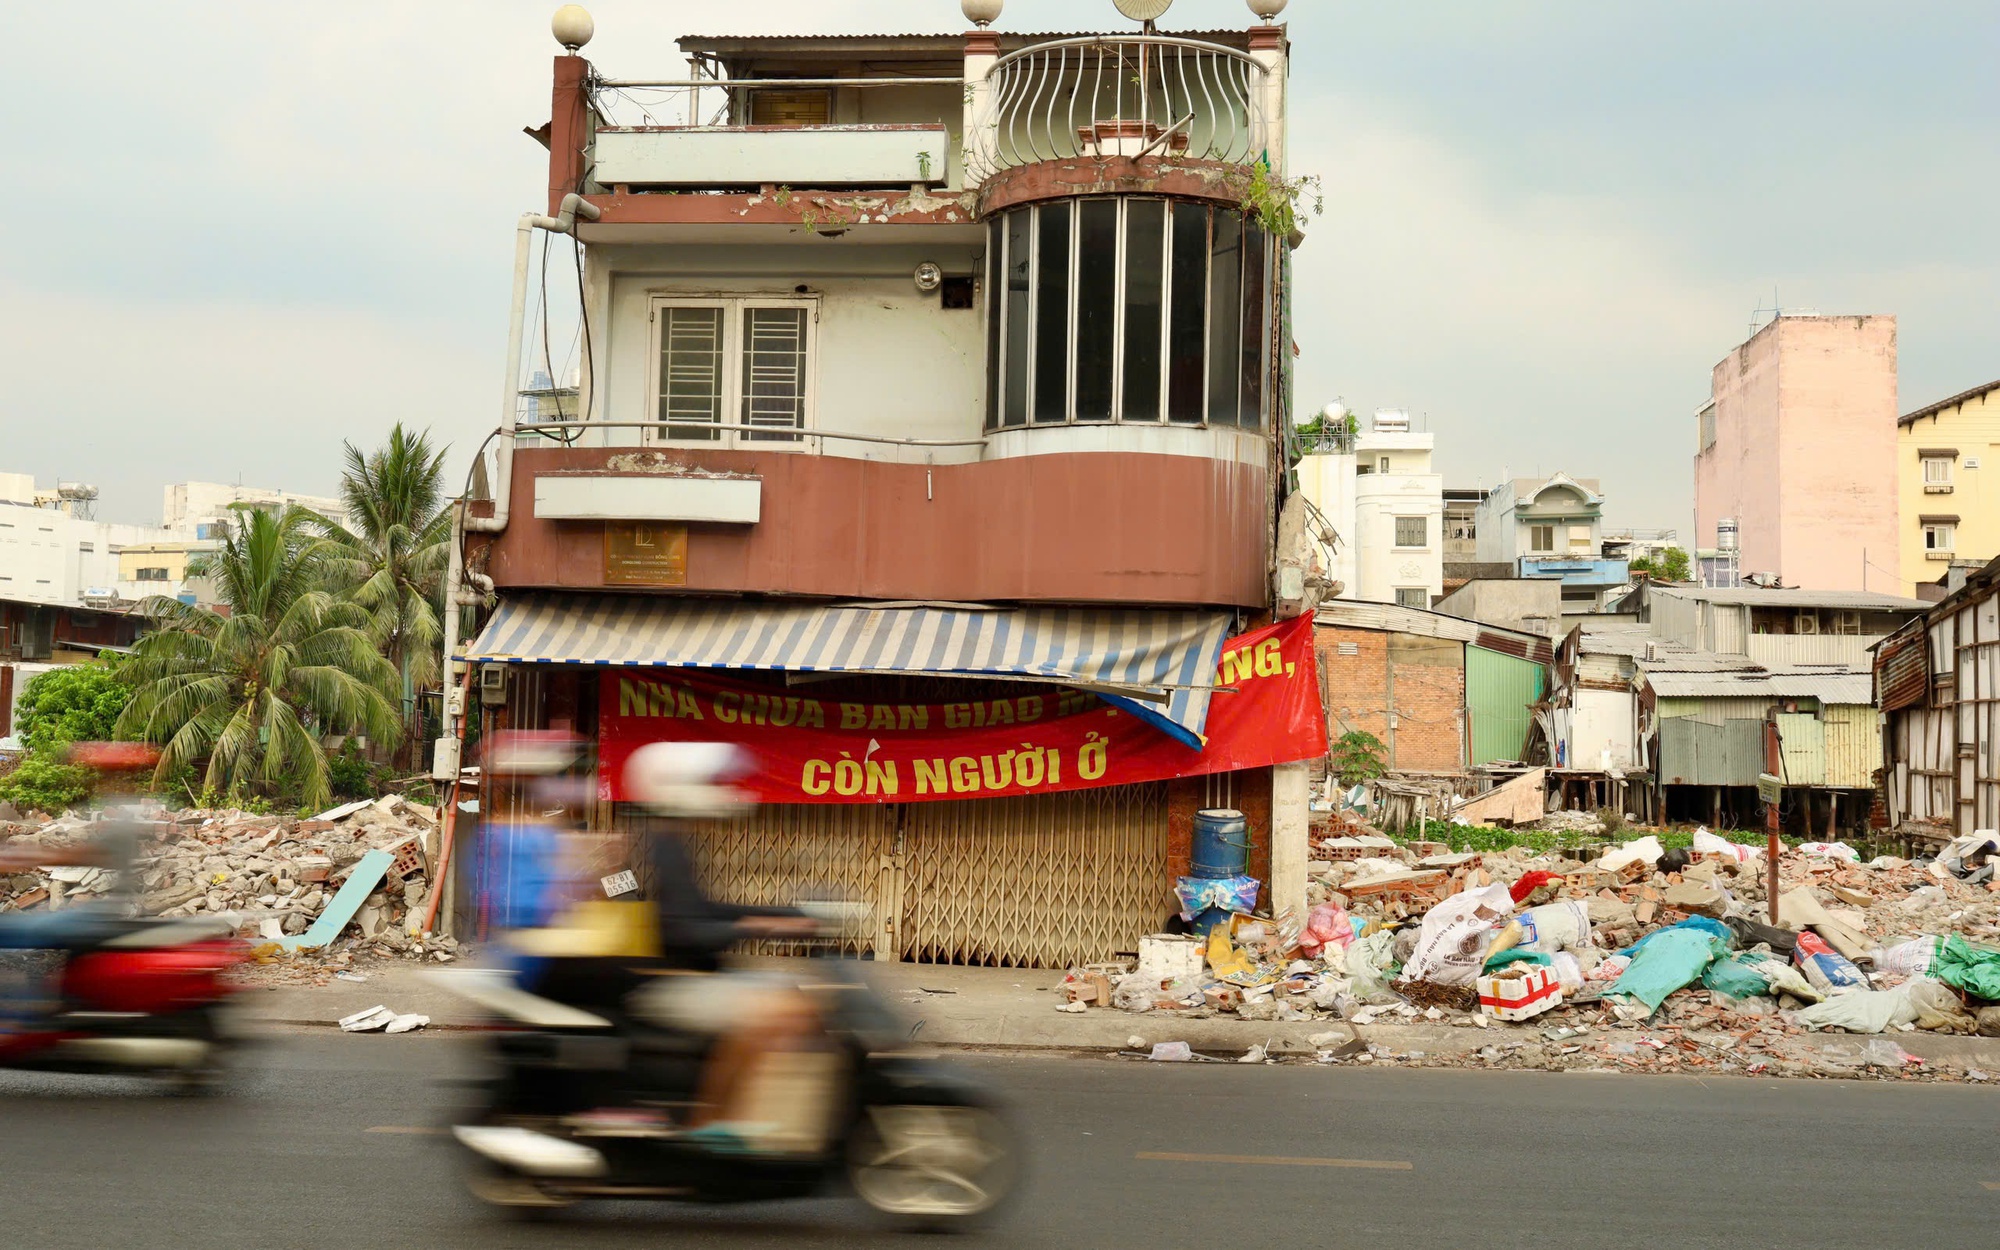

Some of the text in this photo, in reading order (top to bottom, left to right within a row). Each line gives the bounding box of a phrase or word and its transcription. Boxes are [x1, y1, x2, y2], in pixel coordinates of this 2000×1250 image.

[619, 677, 704, 720] NHÀ
[943, 694, 1045, 730] GIAO
[801, 731, 1110, 796] CÒN NGƯỜI Ở
[607, 880, 636, 896] 055.16
